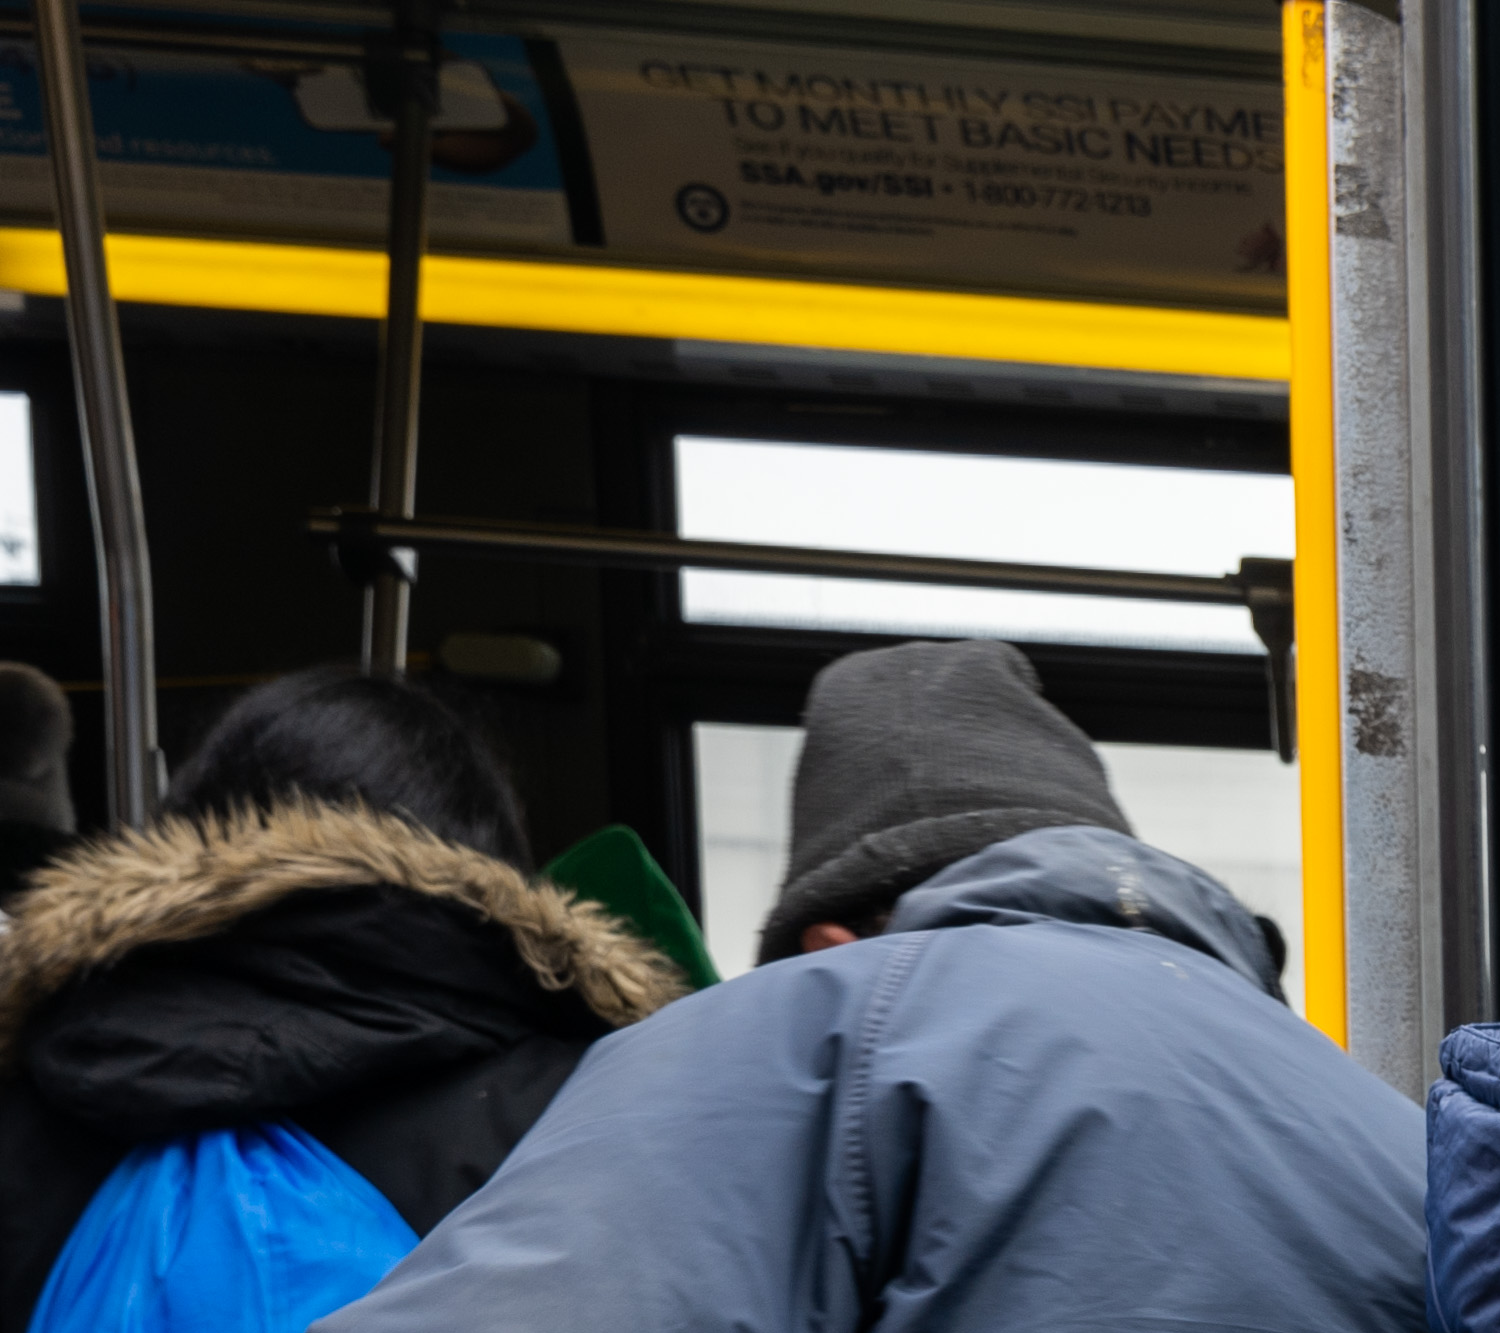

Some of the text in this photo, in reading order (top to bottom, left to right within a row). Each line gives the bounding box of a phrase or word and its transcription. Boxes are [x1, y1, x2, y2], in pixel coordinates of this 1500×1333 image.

[640, 59, 744, 95] GET
[752, 69, 1008, 115] MONTHLY
[1019, 90, 1099, 123] SSI
[717, 97, 1285, 175] TO MEET BASIC NEEDS
[738, 159, 936, 198] SSA.gov/SSI
